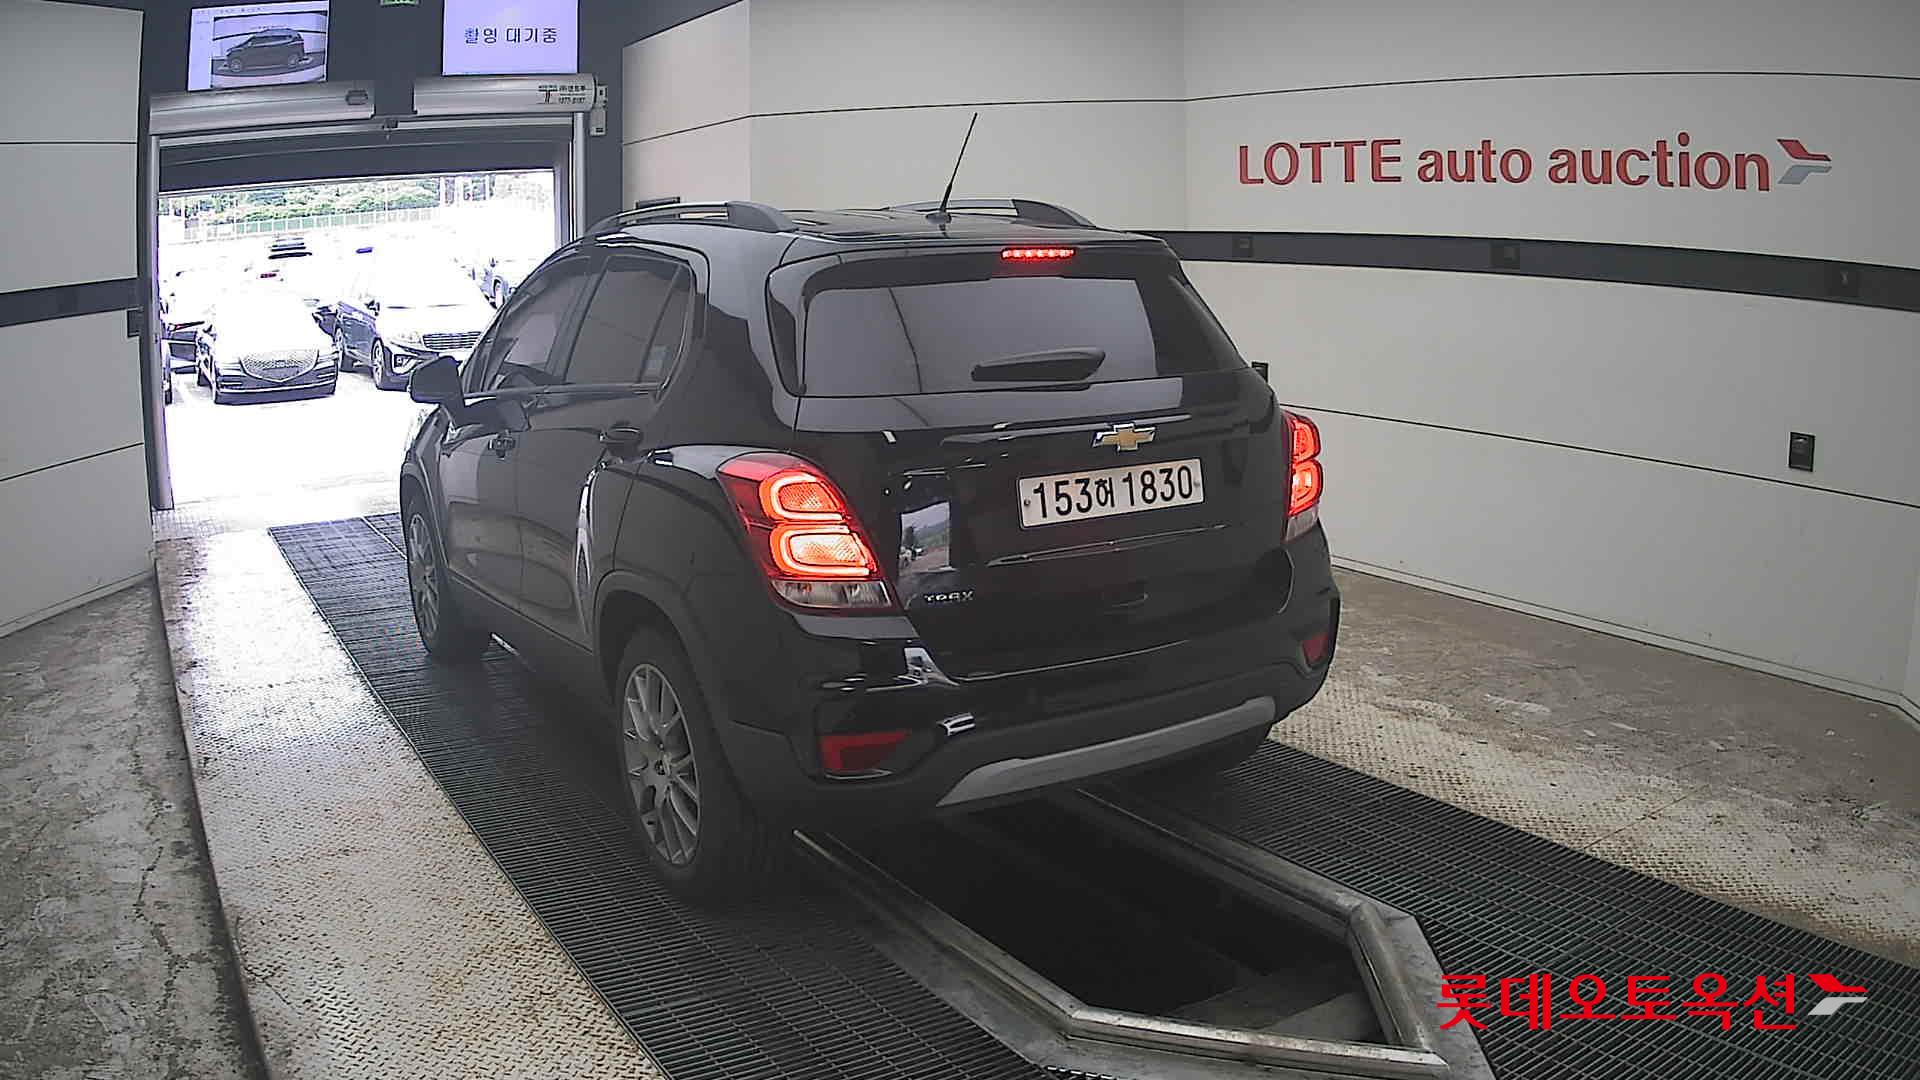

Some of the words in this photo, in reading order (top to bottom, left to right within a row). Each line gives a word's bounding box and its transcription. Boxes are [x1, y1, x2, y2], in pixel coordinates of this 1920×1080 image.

[506, 27, 557, 44] 대기중
[1238, 138, 1402, 186] LOTTE
[1416, 139, 1533, 185] auto
[1547, 131, 1771, 192] auction
